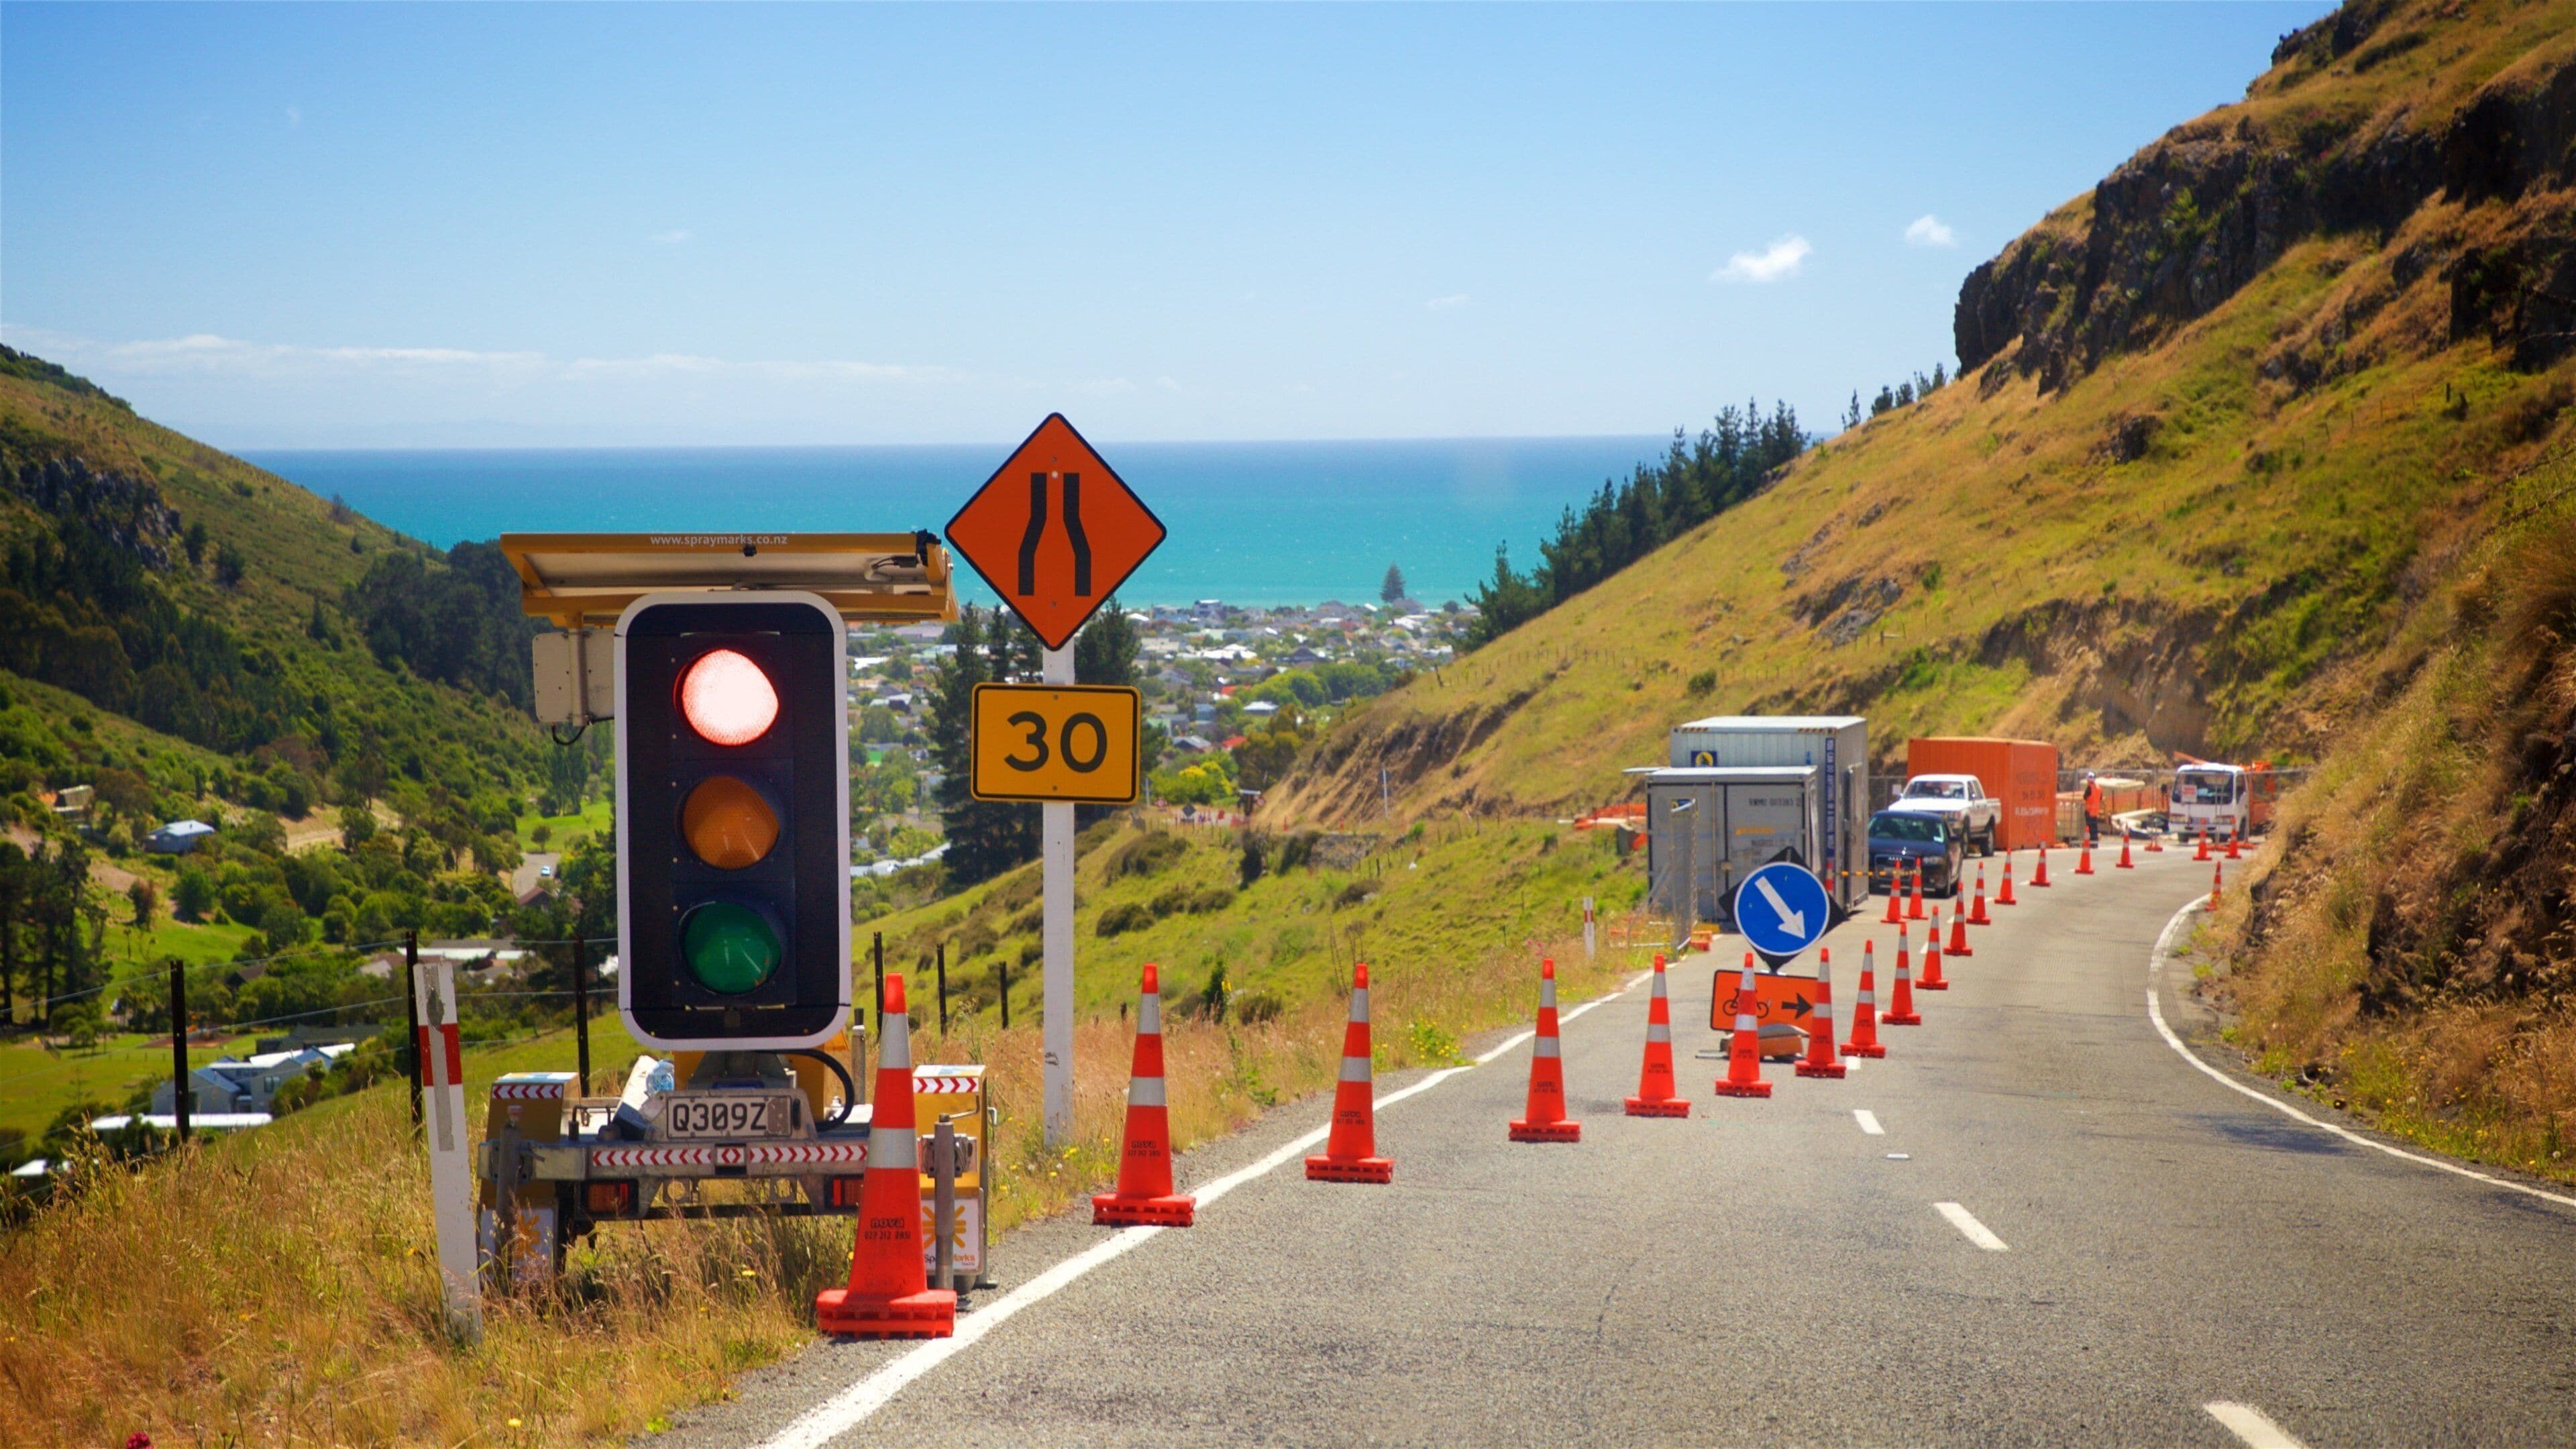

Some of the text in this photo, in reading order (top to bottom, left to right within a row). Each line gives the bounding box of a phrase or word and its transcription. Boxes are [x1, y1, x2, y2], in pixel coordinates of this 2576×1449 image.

[650, 534, 788, 547] www.spraymarks.co.nz
[1004, 710, 1108, 773] 30
[673, 1103, 767, 1131] Q309Z
